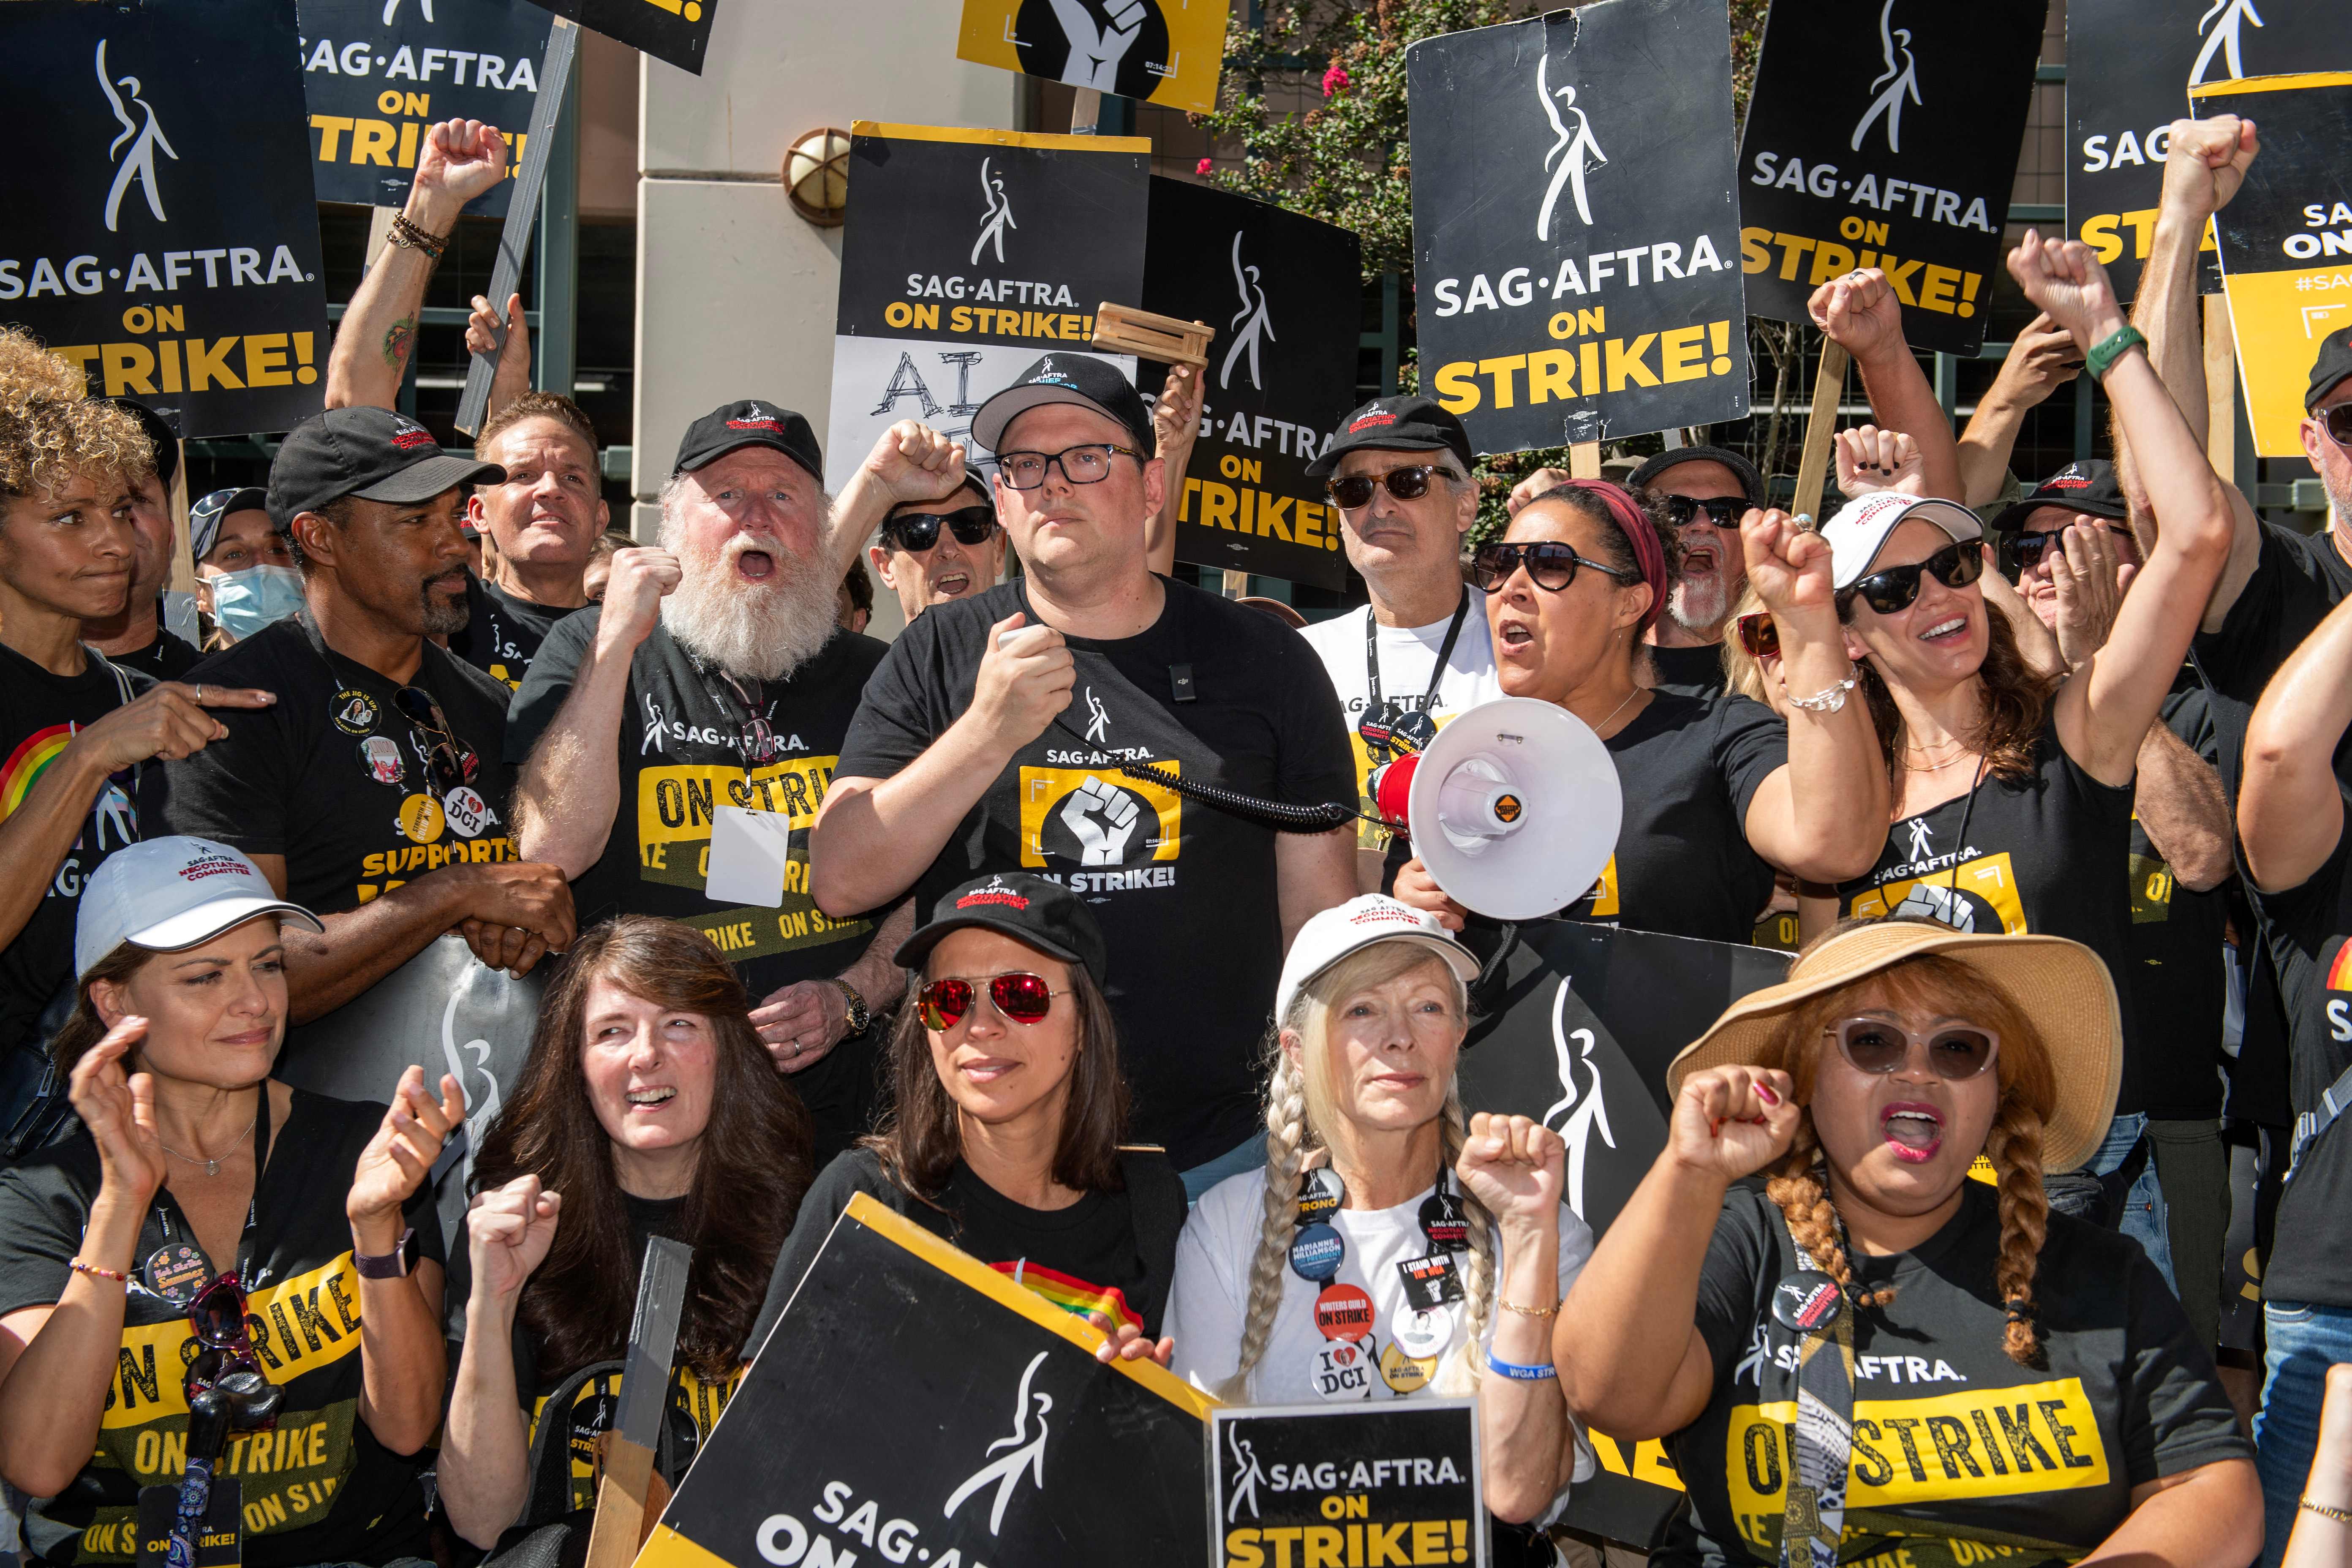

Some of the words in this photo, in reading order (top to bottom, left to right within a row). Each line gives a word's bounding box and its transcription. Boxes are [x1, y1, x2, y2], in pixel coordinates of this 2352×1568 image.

[377, 90, 430, 117] ON
[1840, 216, 1889, 246] ON
[122, 305, 185, 334] ON
[885, 302, 939, 330] ON
[950, 306, 1094, 341] STRIKE!
[1548, 306, 1605, 340] ON
[49, 331, 318, 396] TRIKE!
[1434, 320, 1733, 415] STRIKE!
[1220, 455, 1261, 484] ON
[1176, 477, 1338, 551] TRIKE!
[338, 691, 351, 700] THE
[369, 700, 378, 710] UP!
[457, 789, 468, 805] I
[656, 778, 713, 828] ON
[412, 807, 426, 833] STRENGTH
[416, 799, 435, 840] SOLIDARITY
[448, 801, 480, 833] DCI
[179, 862, 249, 876] NEGOTIATING
[187, 868, 253, 881] COMMITTEE
[1070, 867, 1175, 892] STRIKE!
[778, 911, 808, 939] ON
[1293, 1238, 1334, 1254] MARIANNE
[1293, 1244, 1341, 1260] WILLIAMSON
[1307, 1250, 1341, 1263] PRESIDENT
[154, 1267, 173, 1279] Hot
[173, 1259, 203, 1273] Strike
[1402, 1264, 1407, 1274] I
[1407, 1259, 1431, 1272] STAND
[1430, 1255, 1450, 1266] WITH
[1413, 1269, 1427, 1280] THE
[1427, 1265, 1445, 1277] WGA
[157, 1268, 204, 1289] Summer
[1319, 1300, 1348, 1312] WRITERS
[1348, 1299, 1366, 1309] GUILD
[1319, 1312, 1333, 1326] ON
[1336, 1309, 1370, 1325] STRIKE
[1320, 1352, 1334, 1371] I
[1509, 1367, 1535, 1379] WGA
[1320, 1367, 1367, 1394] DCI
[134, 1431, 185, 1475] ON
[1854, 1399, 2093, 1487] STRIKE
[243, 1493, 287, 1533] ON
[1320, 1494, 1368, 1519] ON
[85, 1524, 117, 1554] ON
[147, 1539, 171, 1552] ON
[1225, 1519, 1469, 1568] STRIKE!
